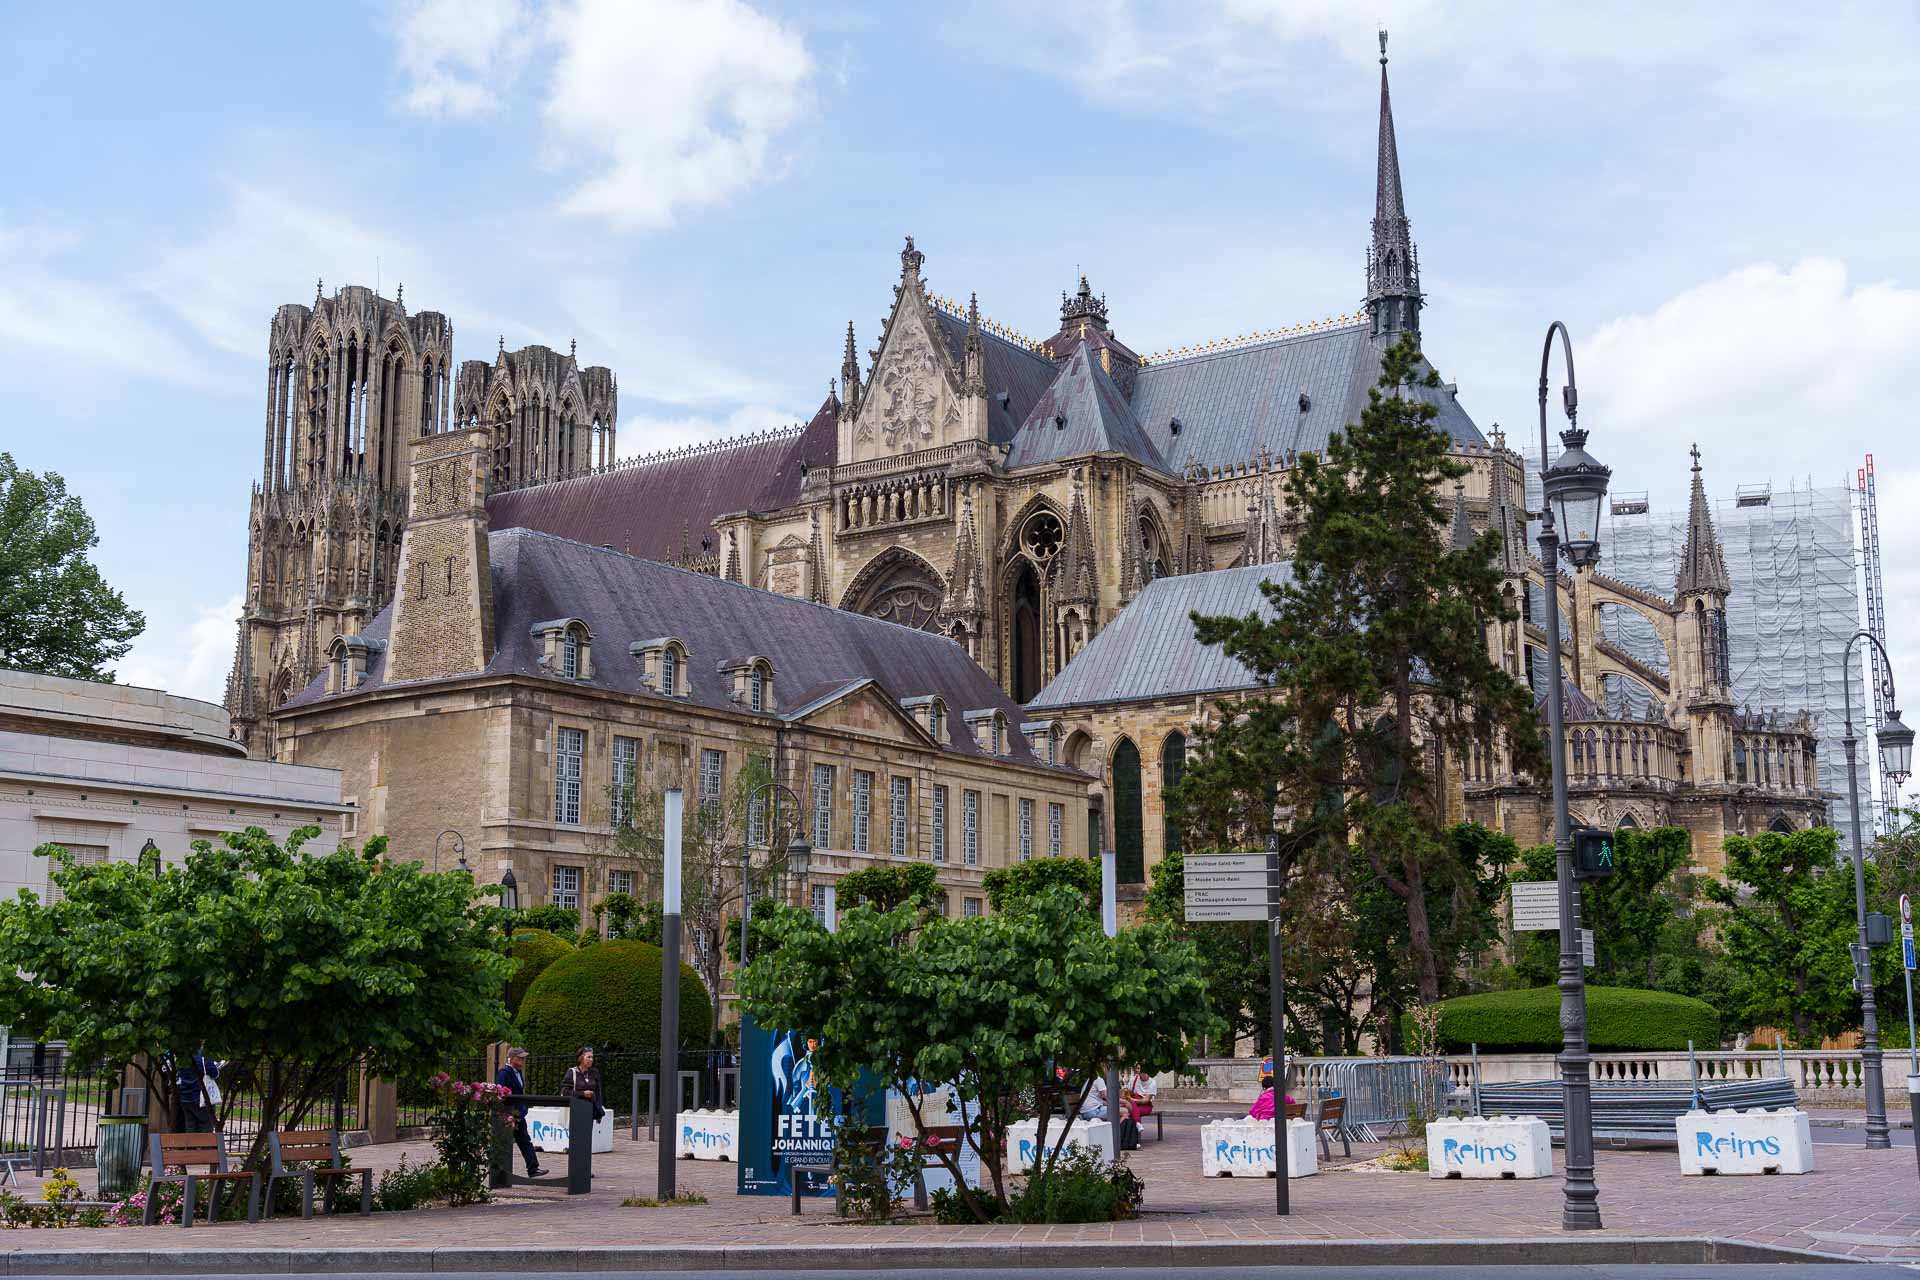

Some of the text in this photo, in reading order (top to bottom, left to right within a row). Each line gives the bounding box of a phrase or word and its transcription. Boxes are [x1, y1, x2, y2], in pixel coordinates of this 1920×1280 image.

[533, 1120, 570, 1141] Reim
[683, 1125, 731, 1149] Reims
[1443, 1138, 1517, 1165] Reims
[1696, 1131, 1781, 1159] Reims
